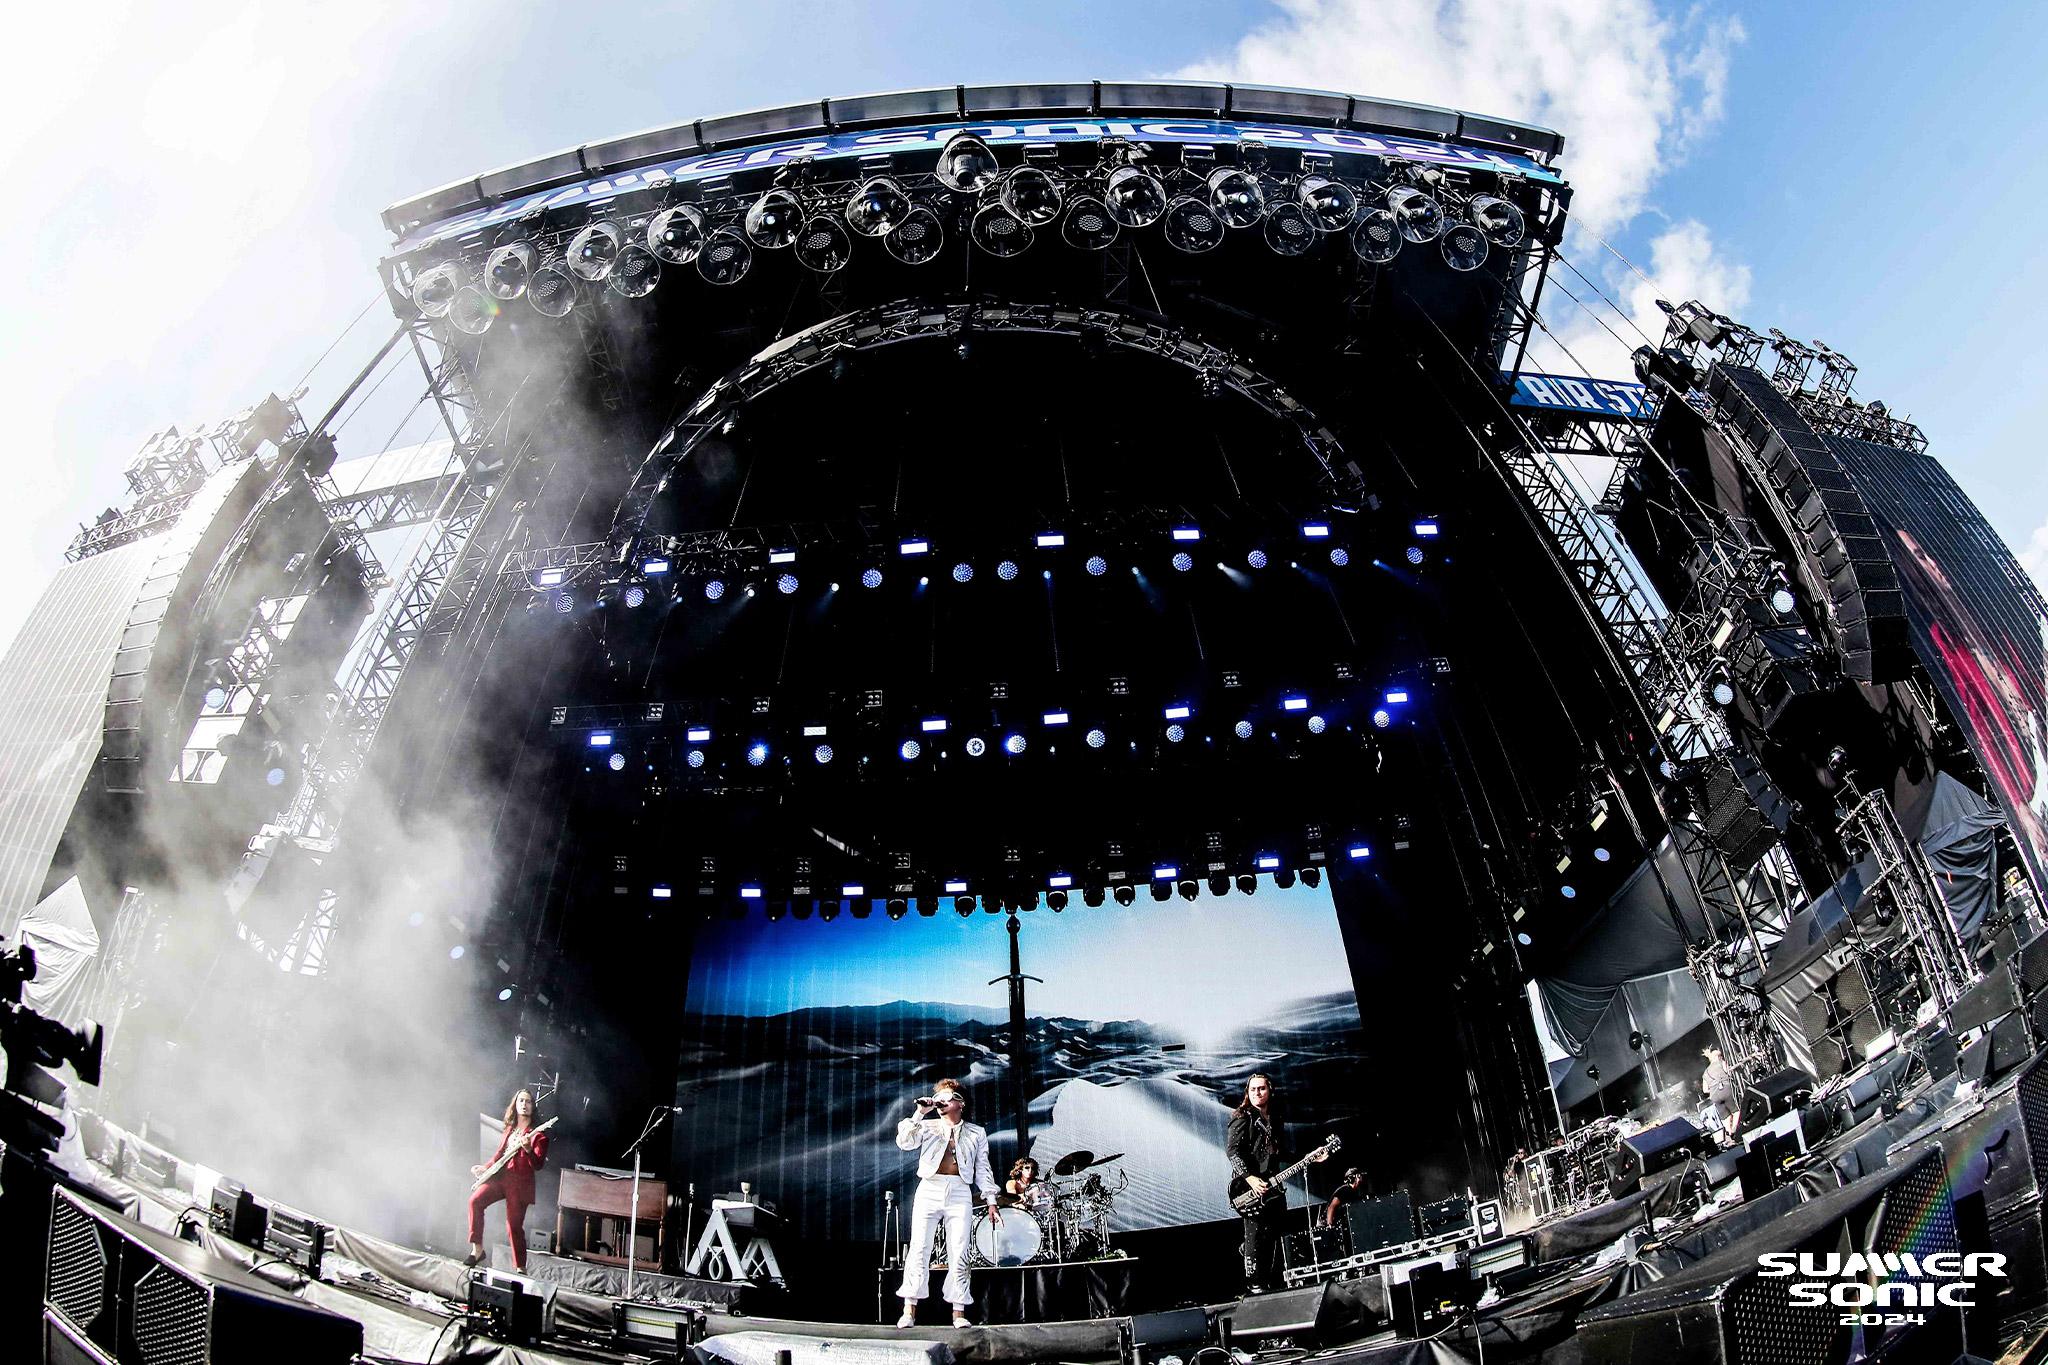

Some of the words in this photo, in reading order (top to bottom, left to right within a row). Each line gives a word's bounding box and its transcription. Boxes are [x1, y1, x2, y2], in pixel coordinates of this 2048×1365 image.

[853, 122, 1217, 150] SONIC
[1234, 126, 1519, 170] 2024
[1519, 375, 1604, 409] AIR
